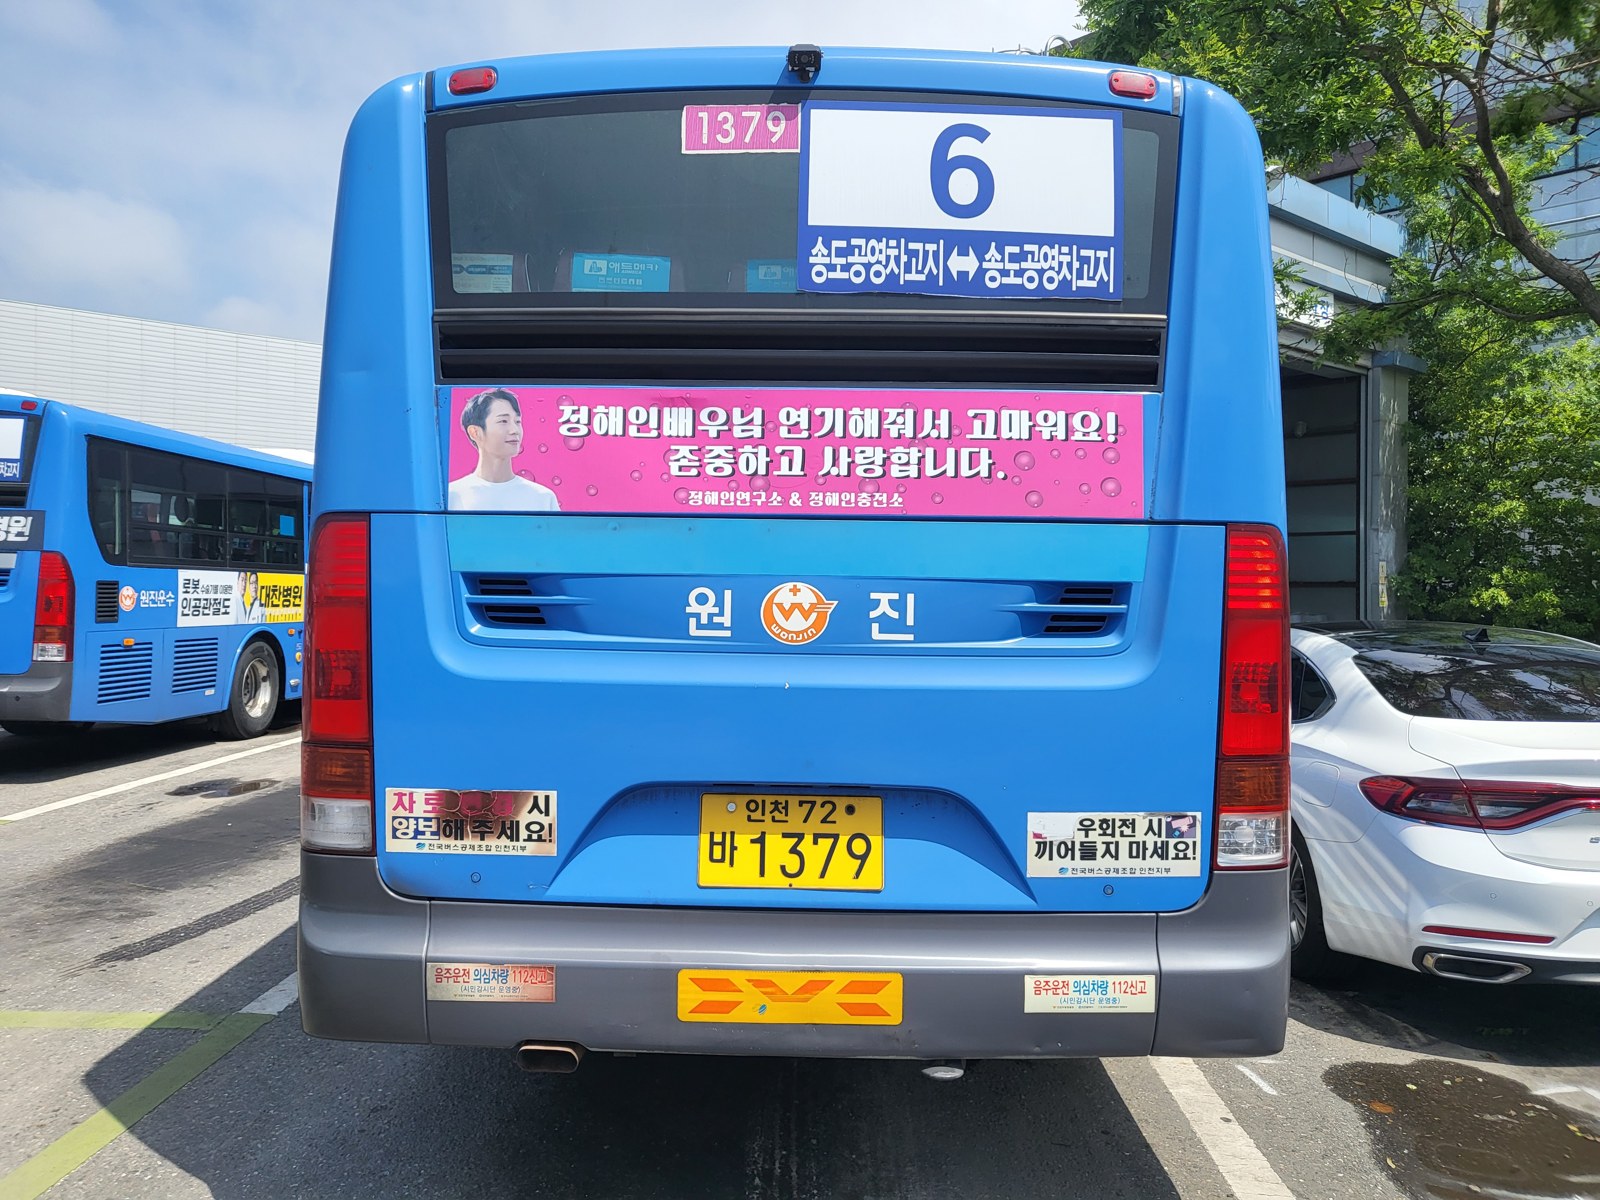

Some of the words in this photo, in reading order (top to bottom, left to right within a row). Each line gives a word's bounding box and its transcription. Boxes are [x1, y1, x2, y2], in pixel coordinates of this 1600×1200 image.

[698, 111, 786, 144] 1379
[929, 122, 996, 219] 6
[808, 236, 944, 285] 송도공영차고지
[982, 241, 1115, 293] 송도공영차고지
[558, 405, 765, 438] 정해인배우님
[778, 407, 952, 440] 연기해줘서
[965, 408, 1119, 443] 고마워요!
[669, 445, 806, 478] 존중하고
[818, 446, 1008, 480] 사랑합니다.
[688, 490, 783, 507] 정해인연구소
[788, 491, 802, 507] &
[808, 491, 905, 508] 정해인충전소
[182, 578, 200, 595] 로봇
[259, 584, 303, 608] 대찬병원
[140, 589, 175, 608] 원진운수
[181, 597, 231, 617] 인공관절도
[686, 586, 732, 637] 원
[869, 592, 915, 641] 진
[527, 794, 550, 817] 시
[745, 799, 789, 823] 인천
[798, 800, 837, 824] 72
[1077, 817, 1137, 839] 우회전
[1144, 817, 1163, 839] 시
[428, 843, 493, 852] 전국버스공제조합
[495, 844, 528, 853] 인천지부
[1034, 840, 1120, 861] 끼어들지
[1128, 840, 1197, 861] 마세요!
[1071, 867, 1137, 875] 전국버스공제조합
[1139, 866, 1171, 875] 인천지부
[435, 967, 471, 984] 음주운전
[473, 967, 510, 984] 의심차량
[512, 968, 548, 985] 112신고
[1033, 979, 1070, 996] 음주운전
[1072, 979, 1109, 996] 의심차량
[1112, 980, 1147, 996] 112신고
[1060, 996, 1096, 1005] (시민감시단
[1098, 996, 1121, 1005] 운영중)
